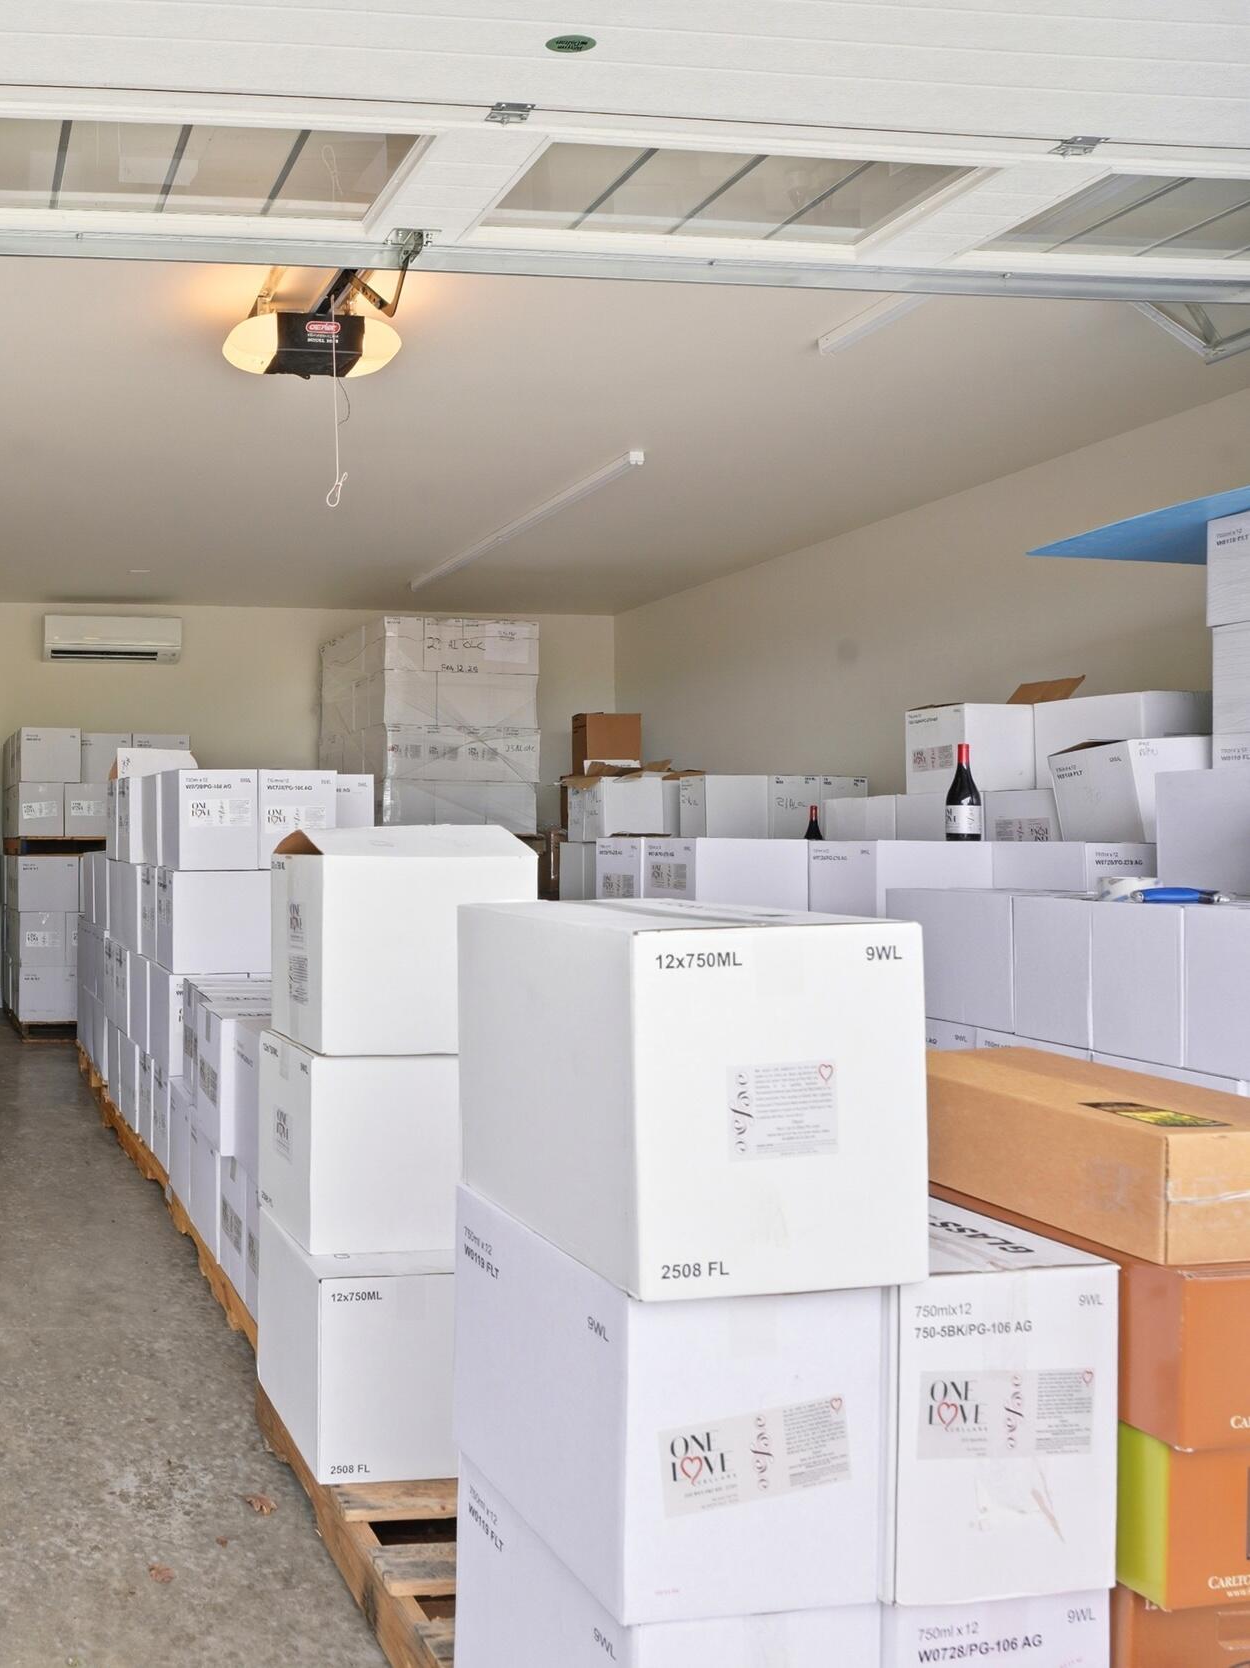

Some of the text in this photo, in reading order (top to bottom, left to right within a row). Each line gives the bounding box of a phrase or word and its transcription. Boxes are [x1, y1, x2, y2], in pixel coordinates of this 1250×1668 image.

[656, 945, 903, 969] 12x750ML 9WL
[464, 1243, 500, 1280] W0119 FLT
[661, 1260, 730, 1280] 2508 FL
[331, 1290, 383, 1303] 12x750ML
[1078, 1294, 1104, 1307] 9WL
[587, 1315, 610, 1343] 9WL
[1015, 1320, 1033, 1333] AG
[930, 1380, 978, 1402] ONE
[1230, 1415, 1250, 1430] CA
[670, 1429, 719, 1458] ONE
[330, 1463, 370, 1475] 2508 FL
[468, 1502, 505, 1552] W0119 FLT
[1066, 1607, 1097, 1624] 9WL
[592, 1627, 617, 1661] 9WL
[1021, 1633, 1043, 1649] AG
